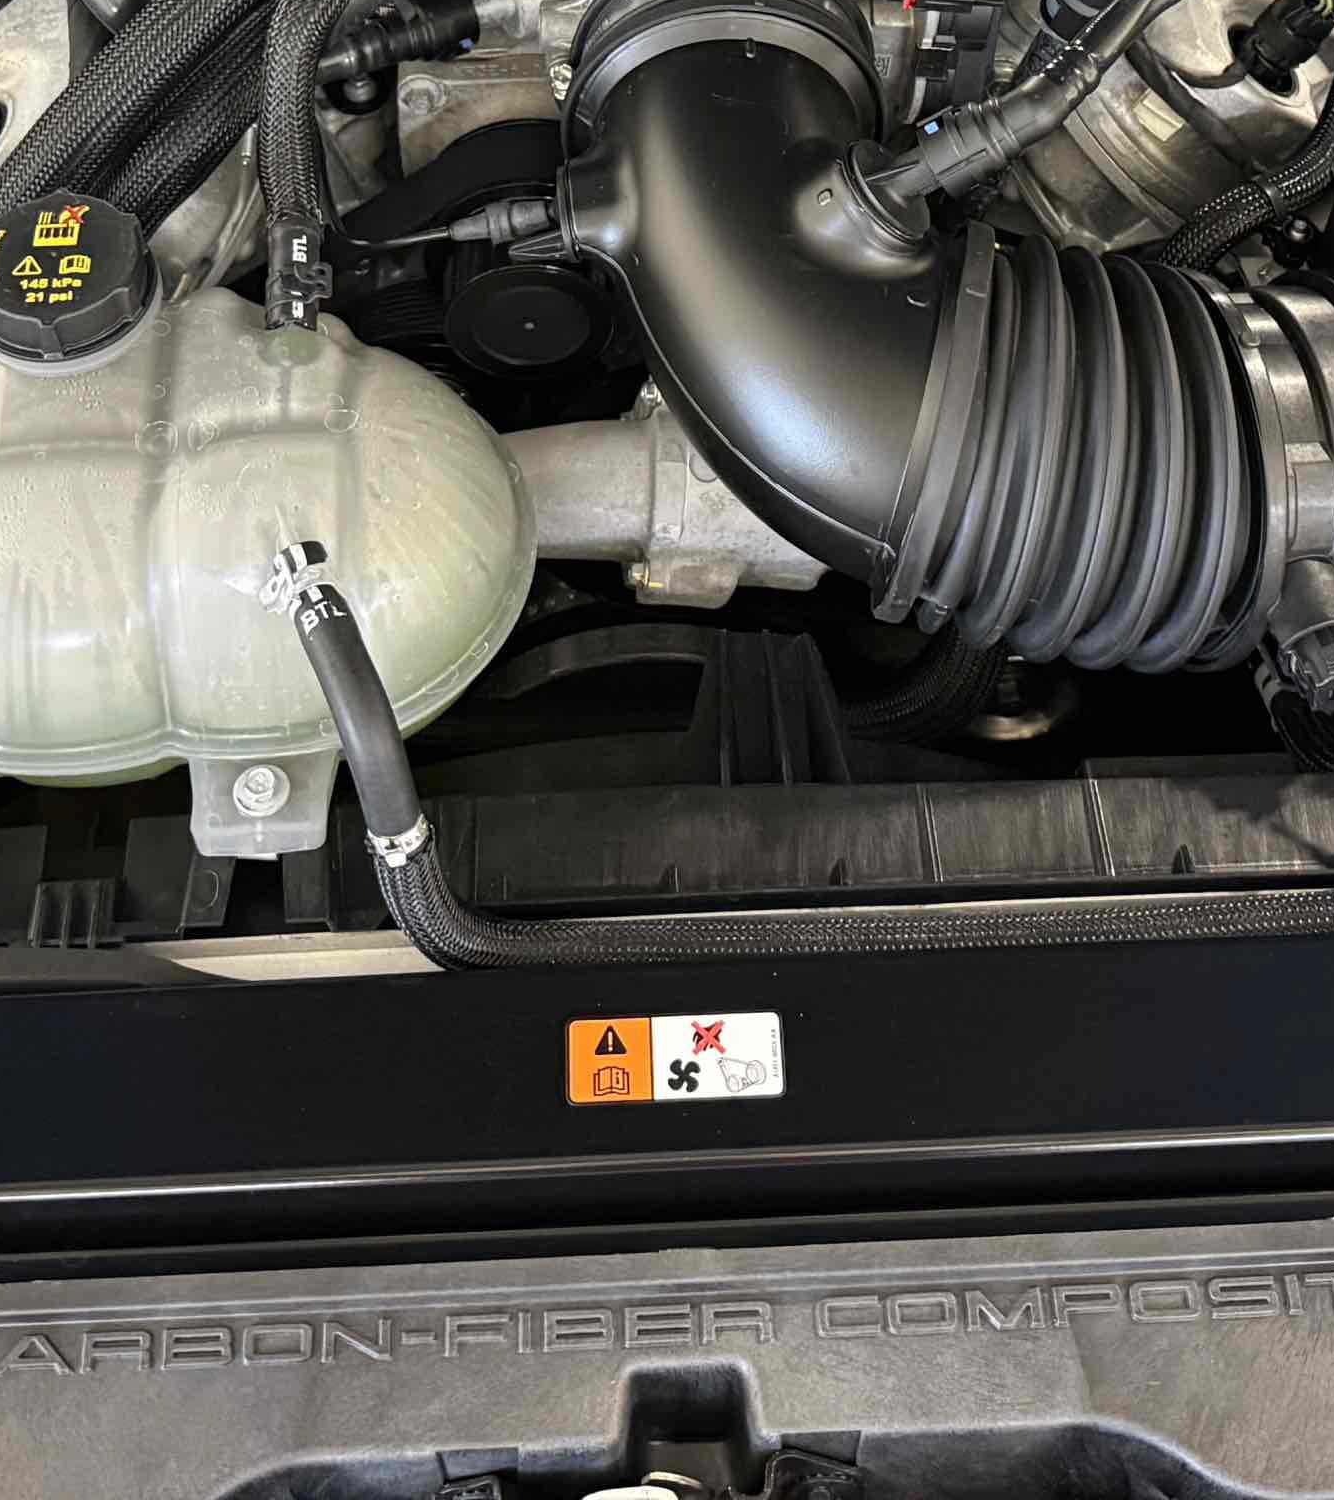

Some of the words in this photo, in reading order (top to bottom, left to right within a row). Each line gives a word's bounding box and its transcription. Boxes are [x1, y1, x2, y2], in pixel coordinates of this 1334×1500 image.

[20, 278, 48, 290] 145
[52, 277, 82, 288] kPa
[25, 291, 44, 303] 21
[49, 290, 73, 304] psi
[300, 601, 347, 635] BTL
